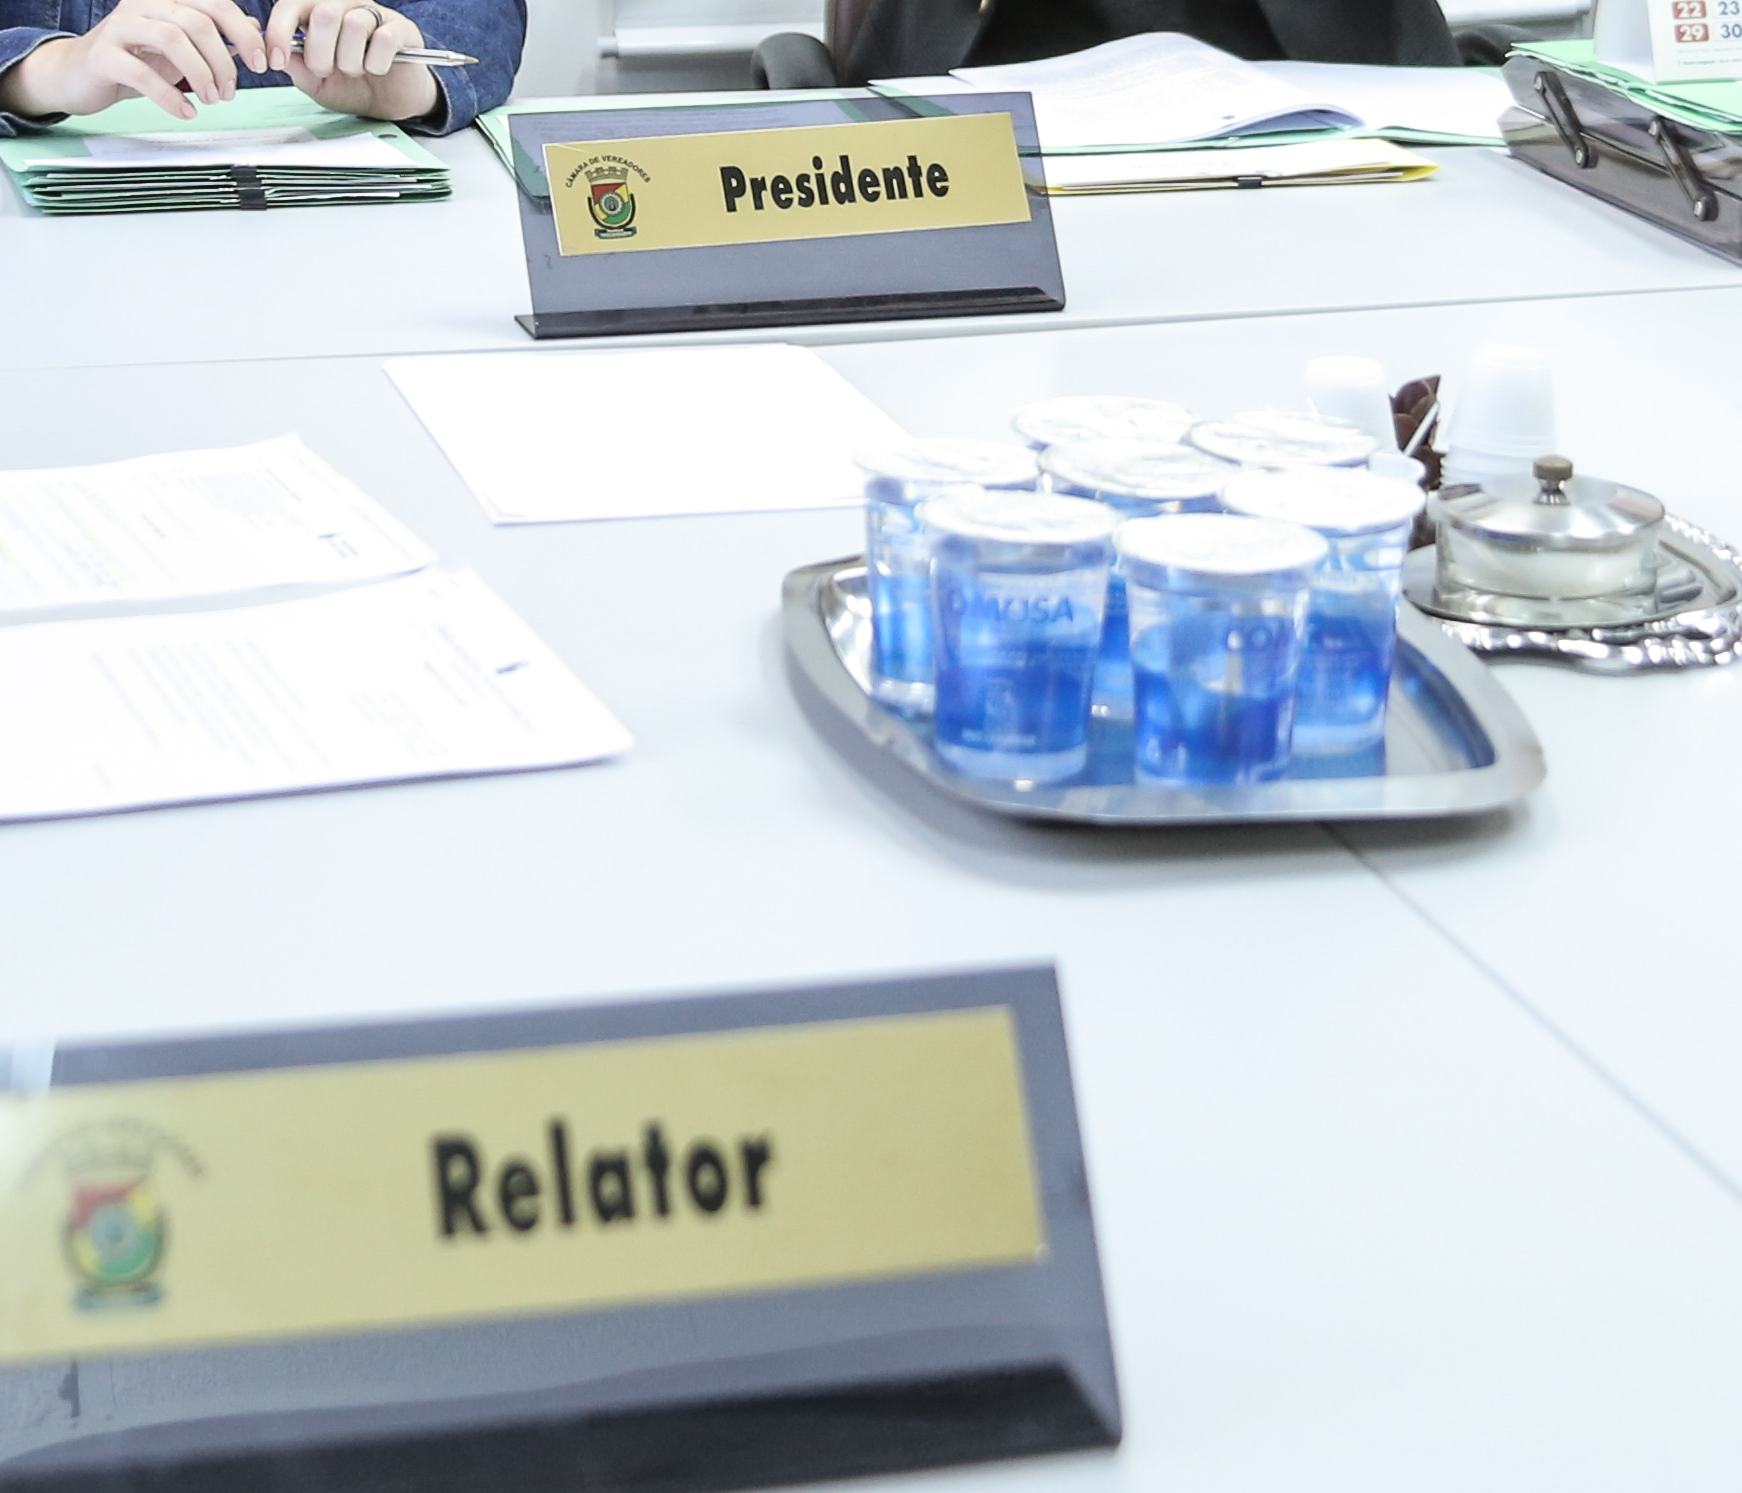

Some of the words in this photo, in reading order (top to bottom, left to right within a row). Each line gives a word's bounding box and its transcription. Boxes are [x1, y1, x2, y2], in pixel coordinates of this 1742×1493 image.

[1677, 3, 1701, 17] 22
[1718, 1, 1740, 16] 23
[1680, 26, 1704, 40] 29
[1720, 24, 1742, 38] 30
[588, 156, 600, 165] DE
[601, 155, 651, 183] VEREADORES
[720, 154, 950, 213] Presidente
[428, 1114, 774, 1244] Relator
